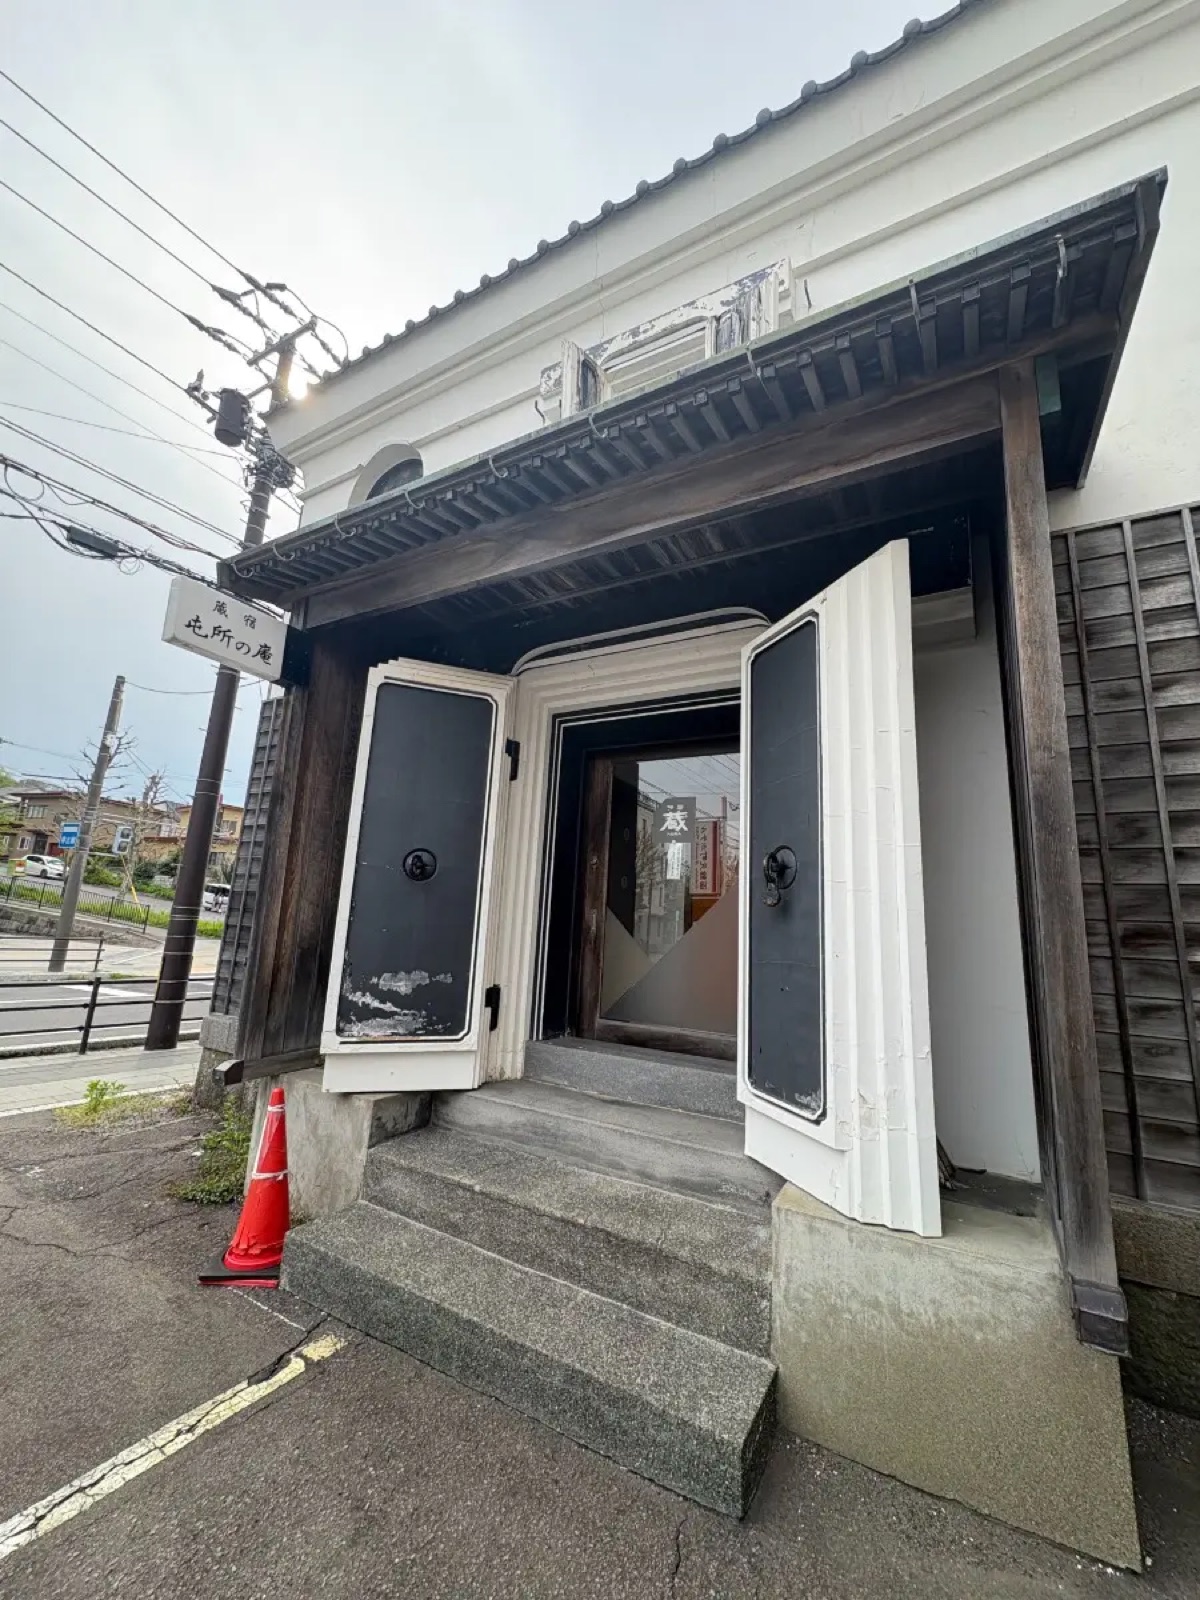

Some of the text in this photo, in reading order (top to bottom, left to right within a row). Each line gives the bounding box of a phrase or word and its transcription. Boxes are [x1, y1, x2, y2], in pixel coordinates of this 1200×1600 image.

[184, 614, 273, 666] 屯所の庵
[659, 803, 689, 832] 蔵
